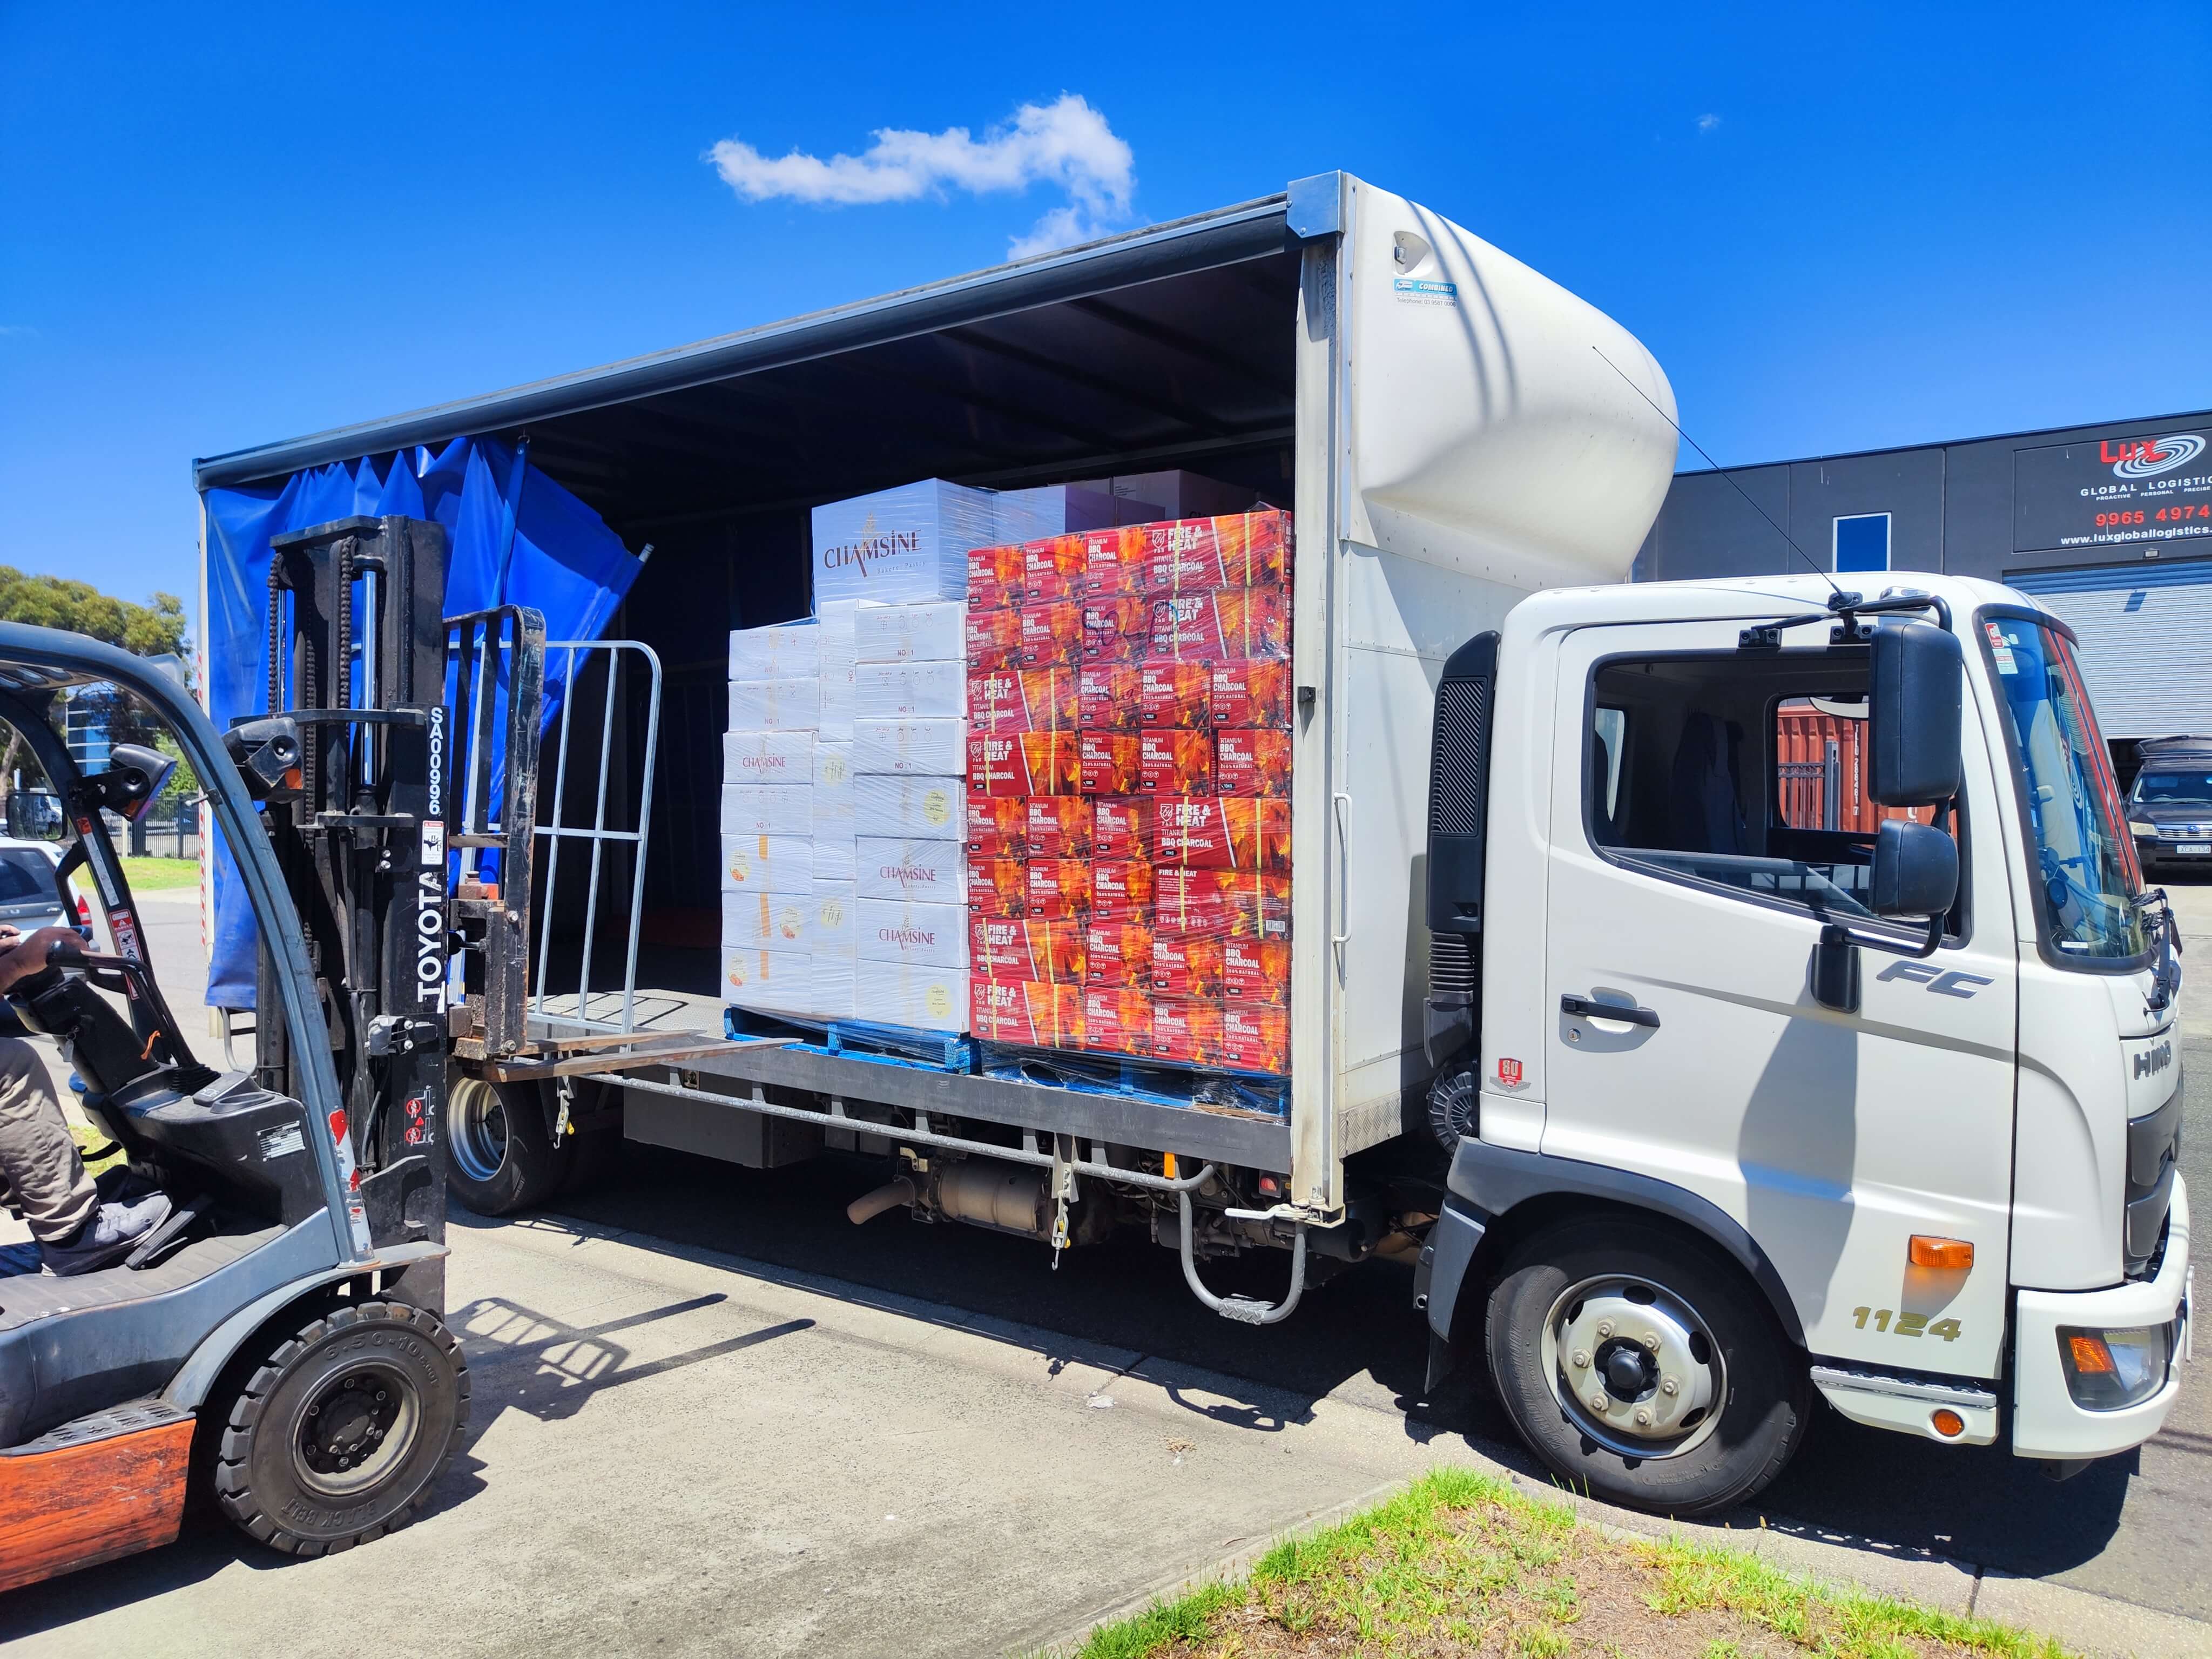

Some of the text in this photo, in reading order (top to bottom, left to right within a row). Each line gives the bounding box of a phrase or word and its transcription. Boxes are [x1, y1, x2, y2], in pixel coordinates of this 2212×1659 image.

[1419, 283, 1453, 293] COMBINED
[2100, 440, 2160, 463] Lux
[2081, 484, 2137, 496] GLOBAL
[2096, 504, 2210, 527] 9965 4974
[1195, 526, 1202, 537] &
[824, 529, 921, 577] CHAMSINE
[1088, 544, 1101, 554] BBQ
[1027, 554, 1038, 563] BBQ
[1088, 551, 1117, 561] CHARCOAL
[1027, 560, 1053, 571] CHARCOAL
[1154, 564, 1167, 574] BBQ
[1194, 597, 1203, 609] &
[1022, 619, 1034, 627] BBQ
[1022, 625, 1050, 636] CHARCOAL
[1154, 632, 1205, 644] BBQ CARCOAL
[1005, 678, 1012, 687] &
[1143, 675, 1156, 684] BBQ
[1213, 674, 1228, 683] BBQ
[1143, 684, 1173, 692] CHARCOAL
[1213, 682, 1246, 691] CHARCOAL
[974, 711, 985, 719] BBQ
[1006, 740, 1013, 750] &
[1082, 743, 1095, 751] BBQ
[1143, 743, 1156, 752] BBQ
[1220, 744, 1235, 752] BBQ
[1082, 751, 1111, 760] CHARCOAL
[1142, 752, 1173, 760] CHARCOAL
[1220, 752, 1253, 761] CHARCOAL
[429, 707, 443, 815] SA00996
[743, 753, 786, 774] CHAMSINE
[973, 772, 984, 781] BBQ
[968, 810, 980, 818] BBQ
[1029, 808, 1042, 817] BBQ
[1097, 808, 1110, 817] BBQ
[1202, 805, 1211, 815] &
[968, 817, 995, 825] CHARCOAL
[1029, 817, 1058, 825] CHARCOAL
[1097, 817, 1127, 825] CHARCOAL
[1162, 838, 1176, 847] BBQ
[880, 864, 936, 888] CHAMSINE
[1030, 872, 1042, 880] BBQ
[1096, 873, 1109, 882] BBQ
[1030, 880, 1057, 888] CHARCOAL
[1096, 882, 1125, 890] CHARCOAL
[988, 924, 1016, 935] FIRE &
[417, 872, 442, 1003] TOYOTA
[879, 927, 935, 950] CHAMSINE
[988, 935, 1013, 945] HEAT
[1090, 936, 1103, 944] BBQ
[1089, 944, 1120, 953] CHARCOAL
[1225, 949, 1240, 958] BBQ
[1225, 958, 1259, 968] CHARCOAL
[1876, 960, 1995, 999] FC
[1009, 987, 1016, 997] &
[976, 1014, 1019, 1026] BBQ CARCOAL
[2134, 1040, 2171, 1080] HINO
[1502, 1060, 1518, 1076] 80
[1853, 1306, 1961, 1341] 1124
[324, 1331, 420, 1360] 6.50-10
[281, 1499, 319, 1526] BELT
